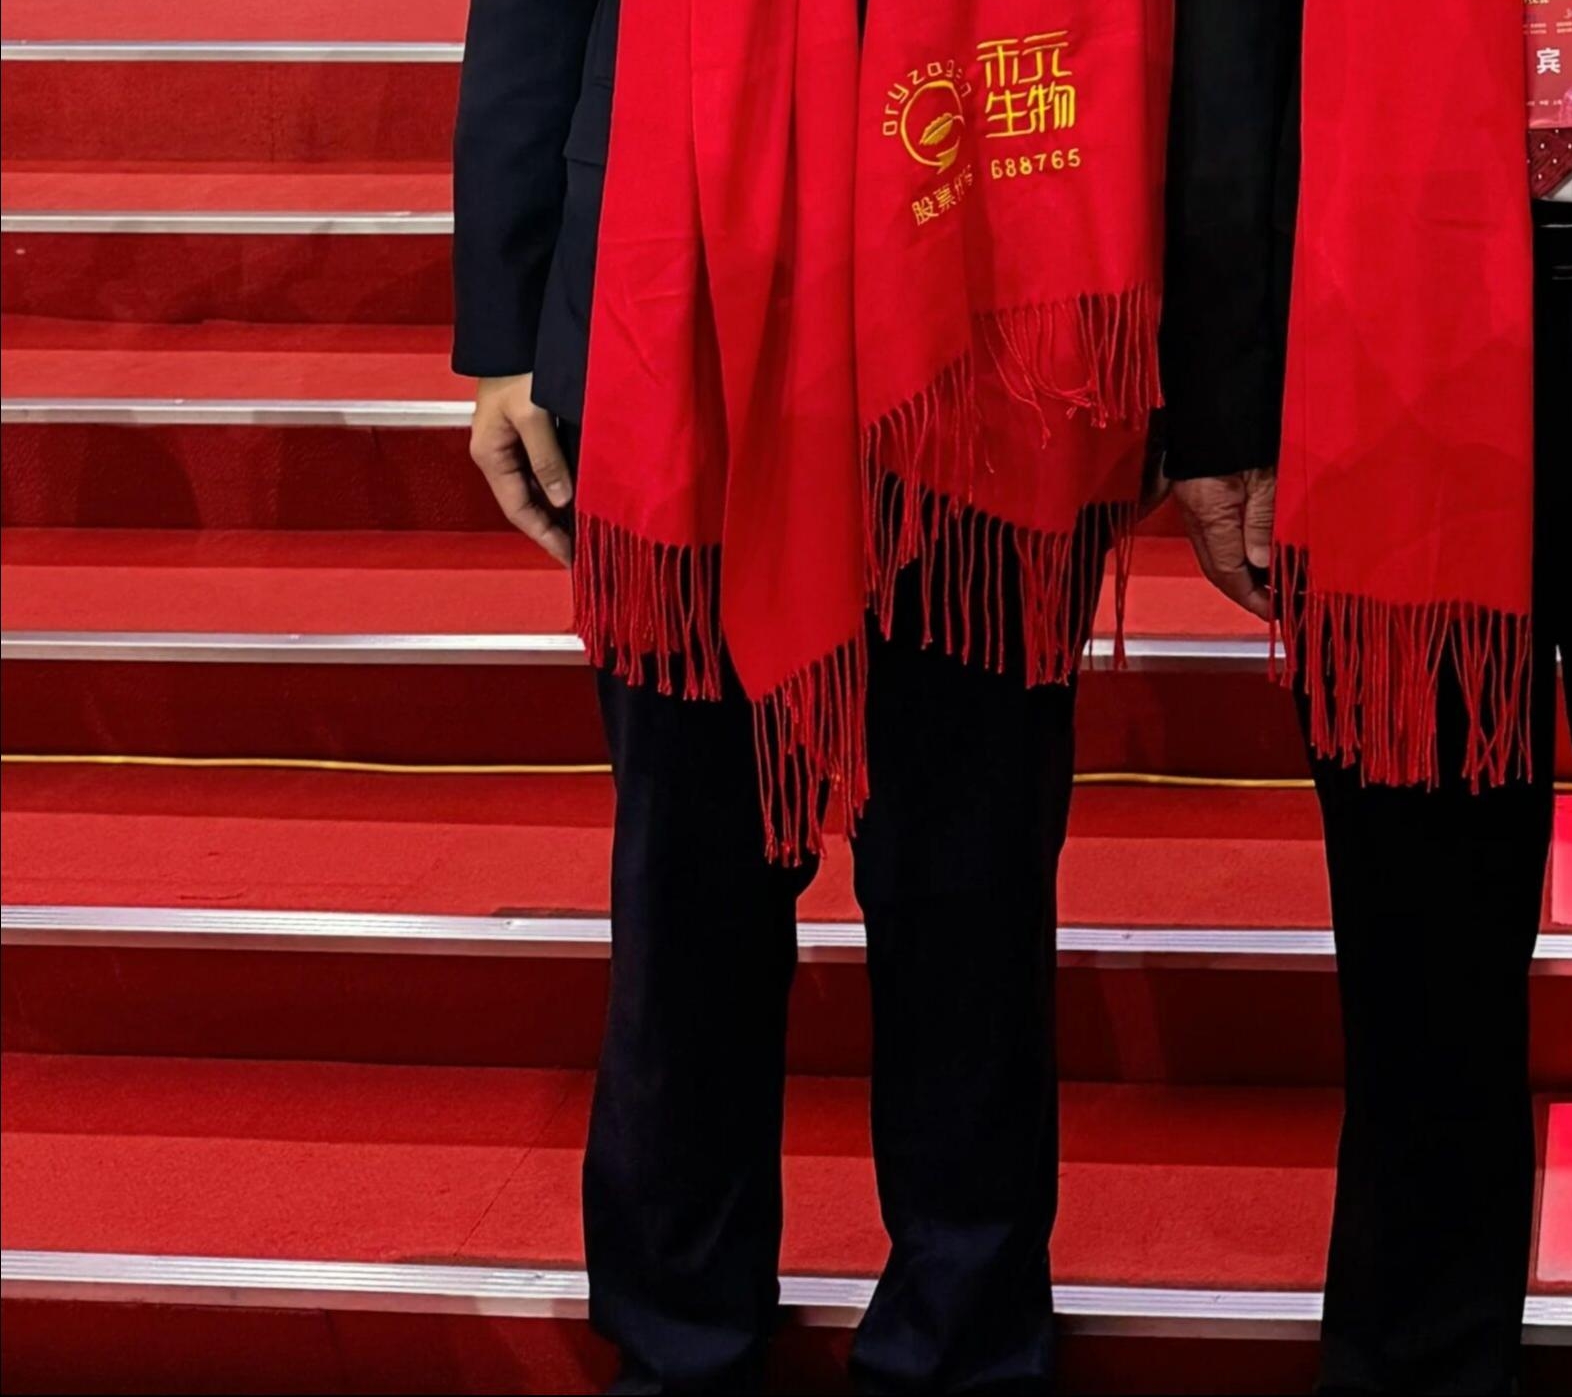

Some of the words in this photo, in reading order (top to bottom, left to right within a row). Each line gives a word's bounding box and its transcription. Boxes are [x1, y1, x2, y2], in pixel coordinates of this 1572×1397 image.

[1536, 47, 1561, 74] 宾
[985, 81, 1075, 139] 生物
[990, 148, 1081, 180] 688765
